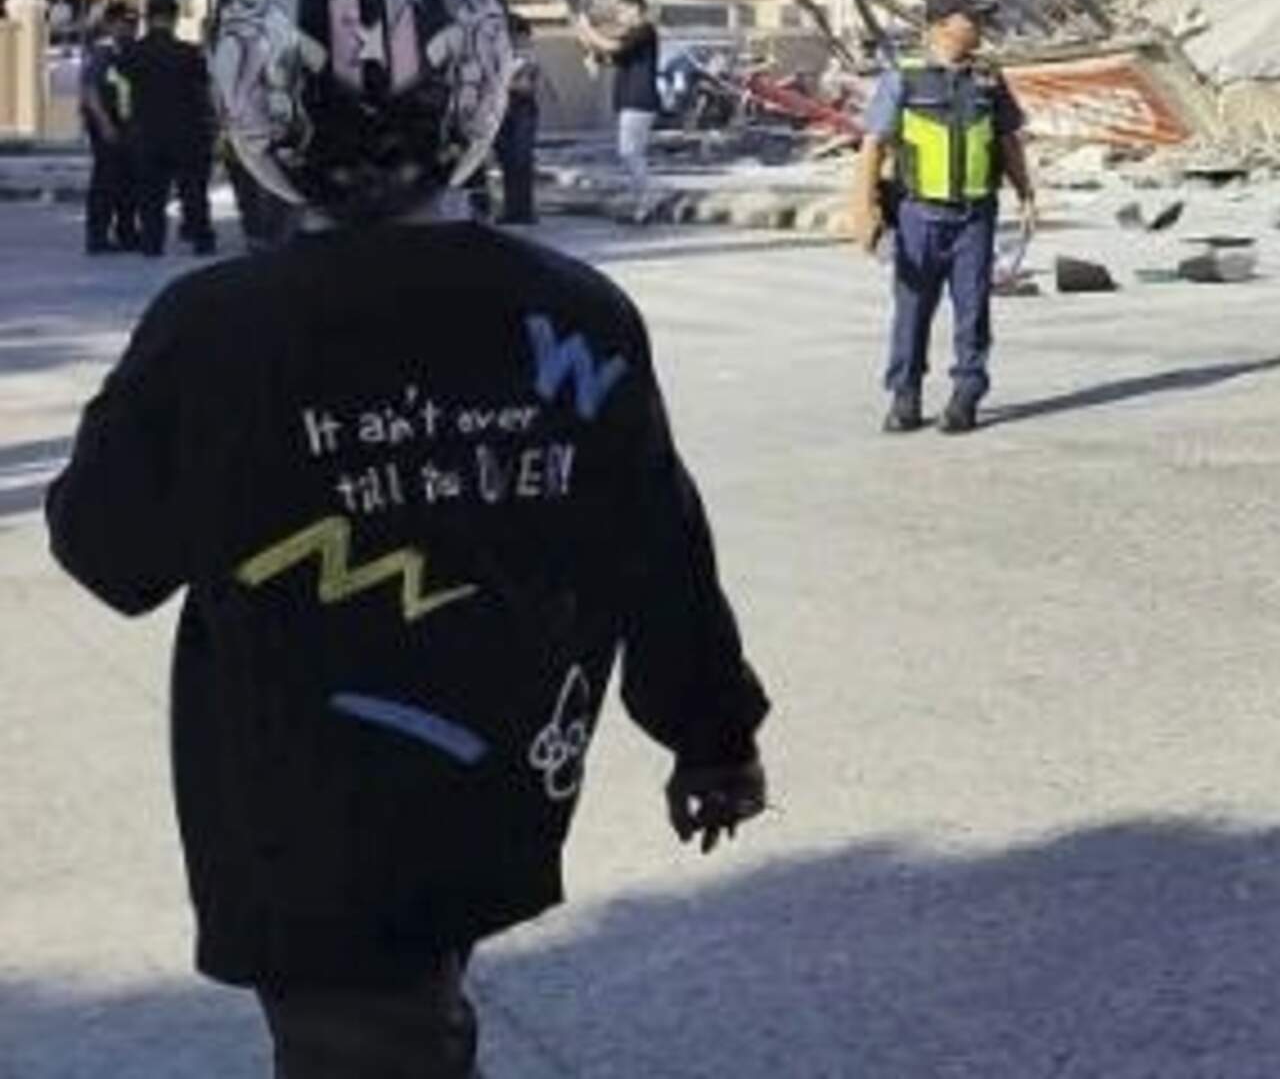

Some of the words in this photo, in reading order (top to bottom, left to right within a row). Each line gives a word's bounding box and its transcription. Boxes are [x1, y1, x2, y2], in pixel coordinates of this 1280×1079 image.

[304, 408, 343, 456] It
[357, 384, 440, 444] ain't
[457, 404, 540, 433] over
[336, 462, 403, 513] till
